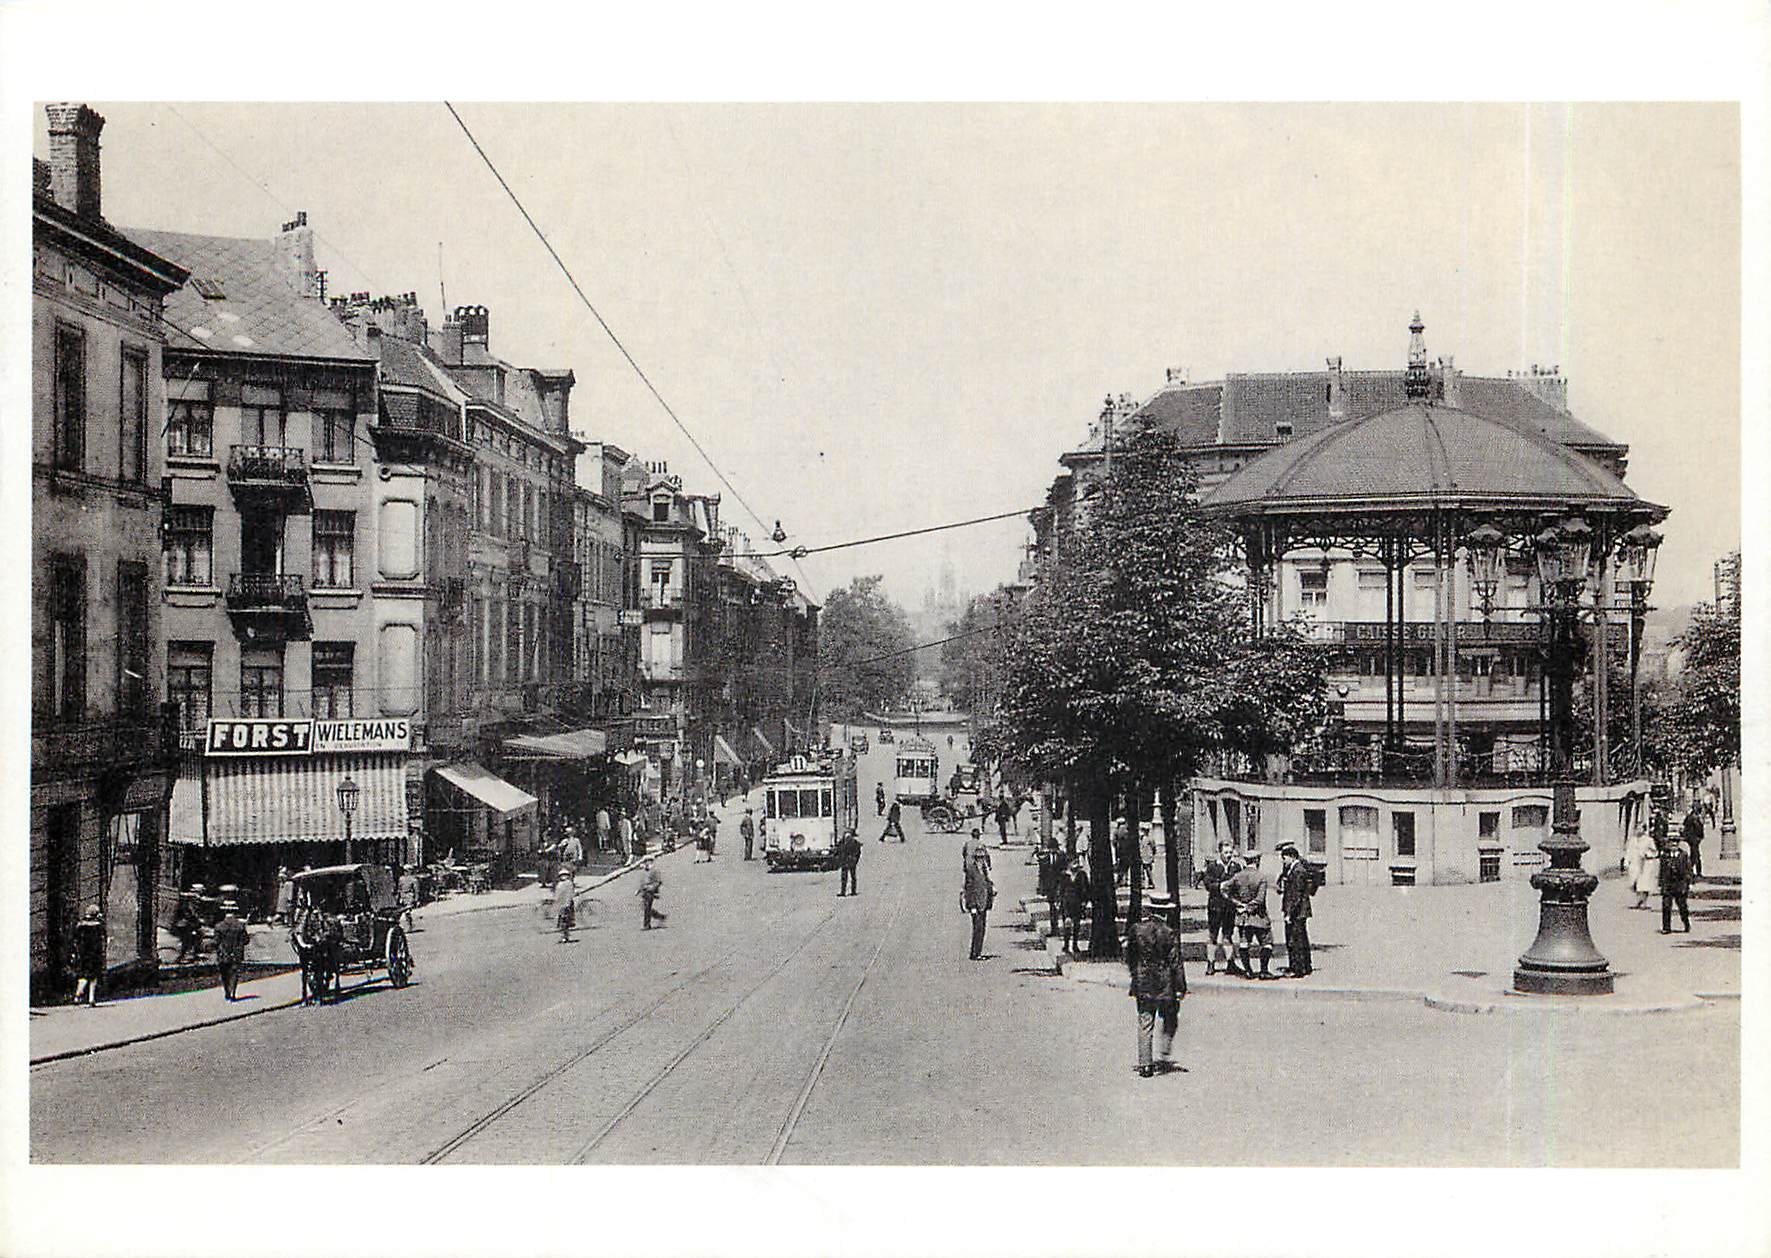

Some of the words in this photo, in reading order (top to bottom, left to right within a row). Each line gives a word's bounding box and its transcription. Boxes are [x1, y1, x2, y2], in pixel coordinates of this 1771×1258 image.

[213, 723, 310, 749] FORST
[317, 722, 408, 742] WIELEMANS
[794, 757, 804, 770] 11
